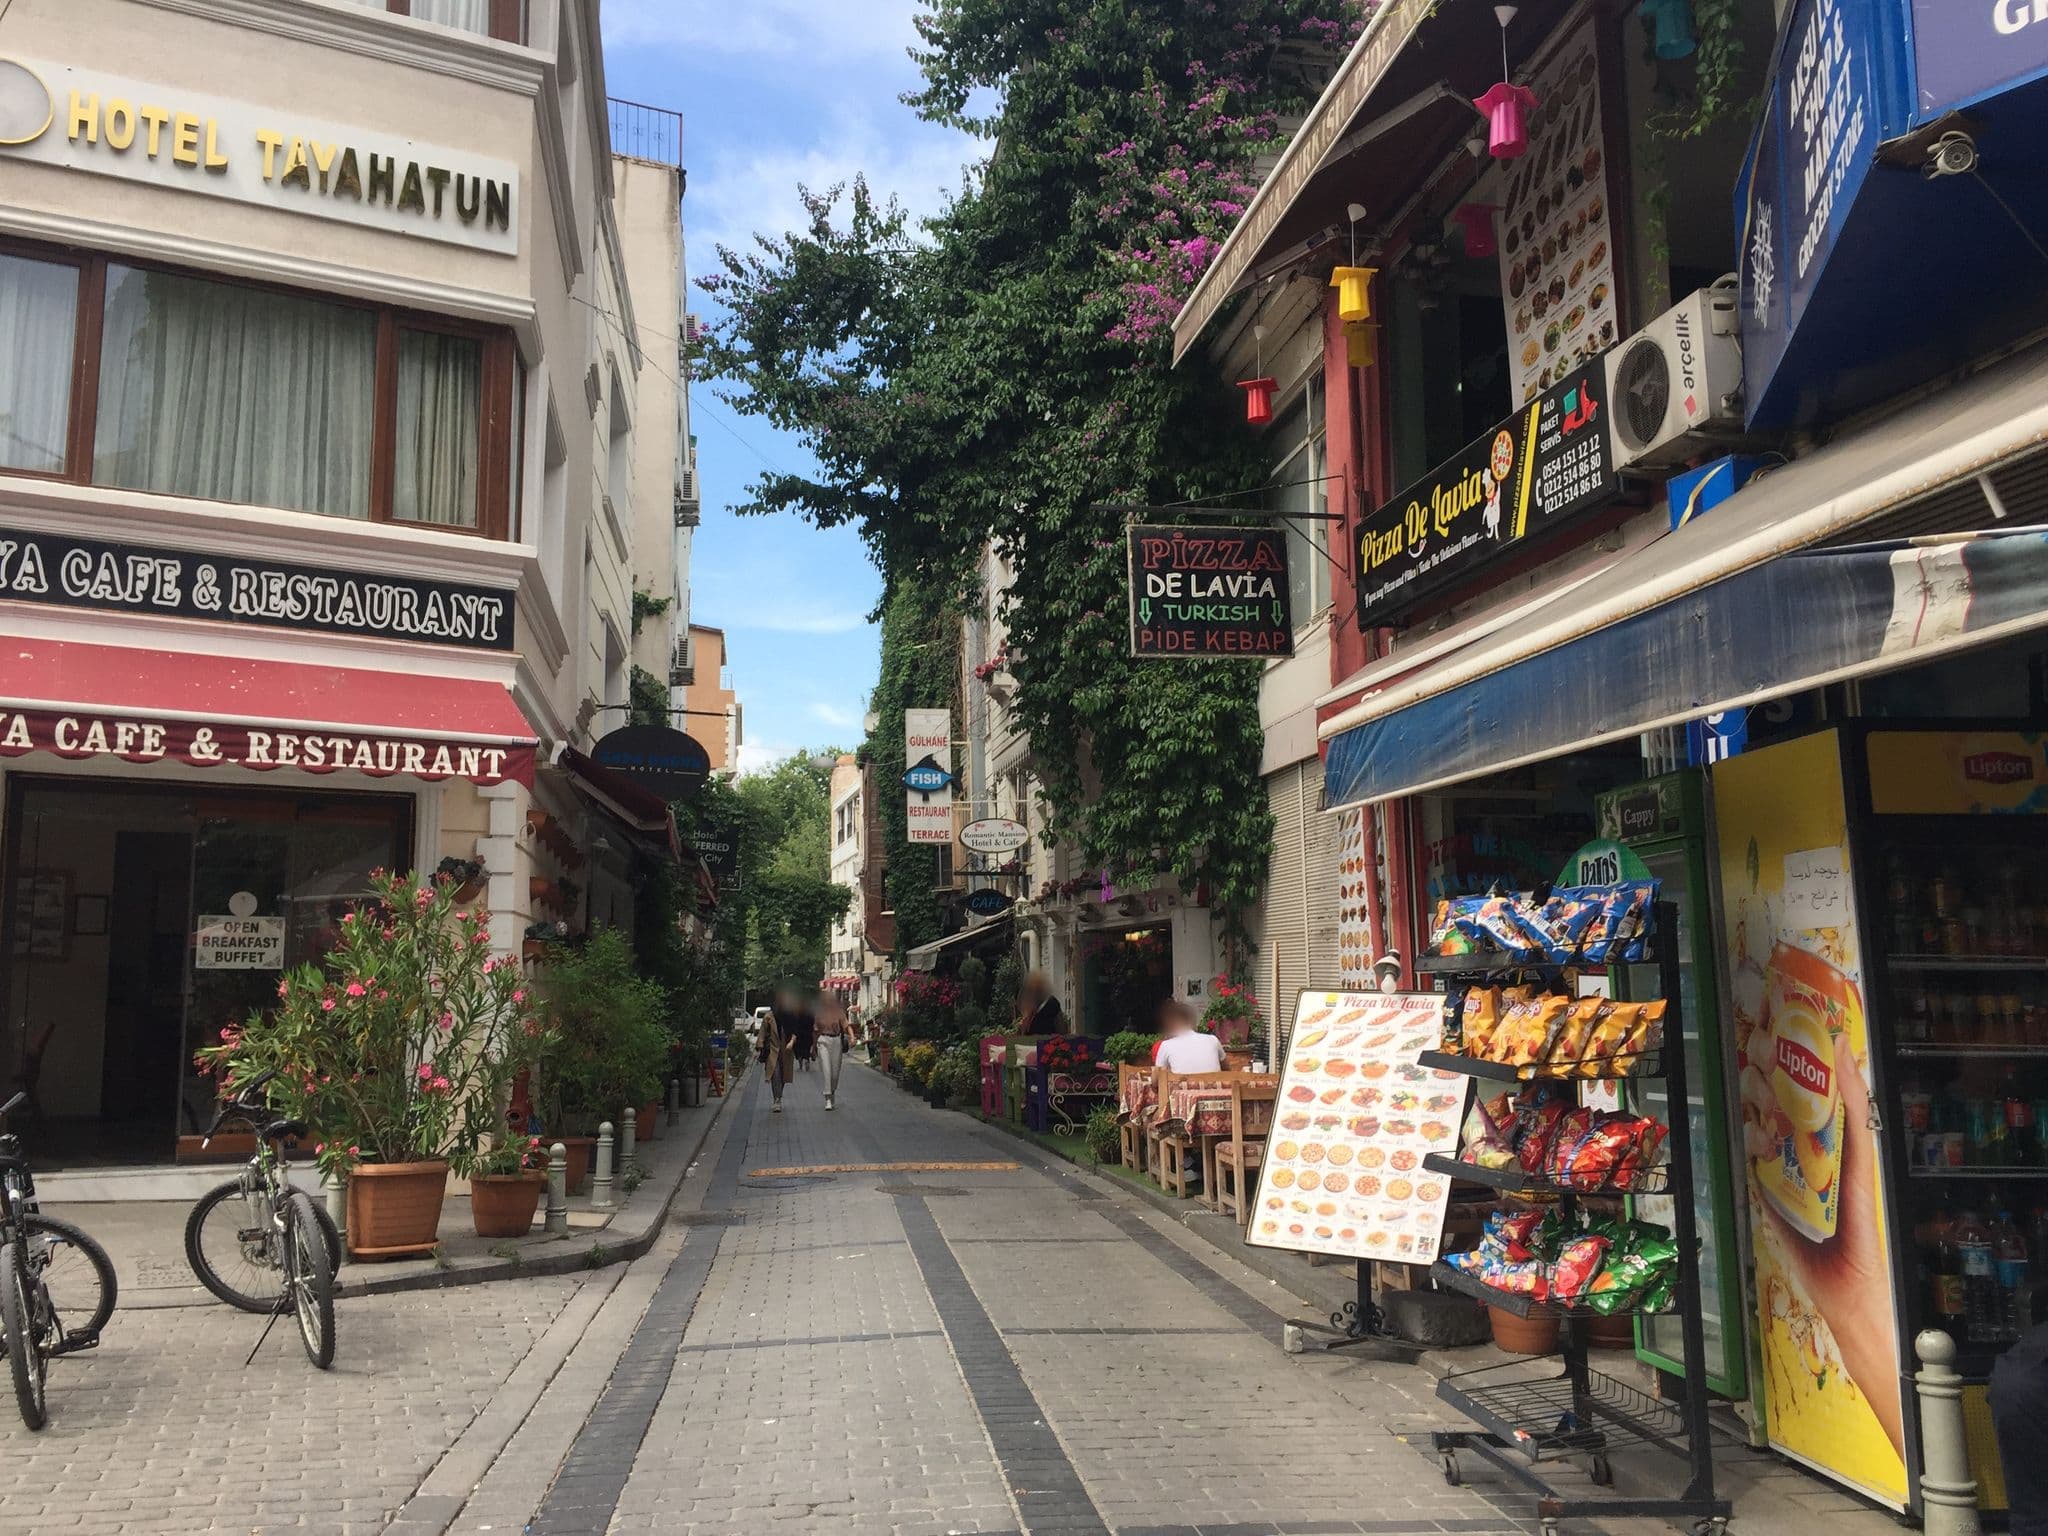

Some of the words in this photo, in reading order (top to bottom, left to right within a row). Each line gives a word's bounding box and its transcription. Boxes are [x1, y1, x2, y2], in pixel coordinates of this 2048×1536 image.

[1790, 11, 1819, 130] AKSU
[1803, 37, 1832, 152] SHOP
[1833, 7, 1845, 65] &
[1804, 47, 1852, 216] MARKET
[67, 89, 228, 173] HOTEL
[256, 128, 511, 233] TAYAHATUN
[1798, 171, 1834, 279] GROCERY
[1835, 94, 1864, 195] STORE
[1676, 314, 1694, 388] arçelik
[1542, 397, 1556, 416] ALO
[1540, 413, 1560, 436] PAKET
[1542, 456, 1561, 481] 0554
[1561, 448, 1577, 469] 151
[1578, 440, 1589, 459] 12
[1589, 433, 1601, 453] 12
[1510, 412, 1531, 537] www.pizzadelavia.com
[1543, 474, 1563, 498] 0212
[1563, 465, 1578, 487] 514
[1578, 458, 1590, 477] 86
[1590, 451, 1602, 471] 80
[1544, 492, 1564, 514] 0212
[1564, 483, 1580, 505] 514
[1579, 476, 1591, 496] 86
[1591, 470, 1603, 490] 81
[1361, 523, 1403, 574] Pizza
[1405, 500, 1429, 545] De
[1431, 467, 1483, 537] Lavia
[1141, 532, 1283, 571] PİZZA
[60, 548, 182, 608] CAFE
[192, 564, 223, 611] &
[229, 568, 503, 641] RESTAURANT
[1146, 572, 1183, 599] DE
[1190, 571, 1277, 599] LAVİA
[1162, 604, 1260, 622] TURKISH
[1140, 626, 1196, 650] PİDE
[1206, 630, 1286, 651] KEBAP
[54, 717, 167, 758] CAFE
[189, 727, 224, 761] &
[246, 731, 507, 778] RESTAURANT
[629, 765, 671, 774] HOTEL
[910, 773, 943, 785] FISH
[1970, 758, 2028, 778] Lipton
[909, 806, 950, 818] RESTAURANT
[1624, 808, 1658, 829] Cappy
[911, 829, 950, 840] TERRACE
[964, 831, 996, 839] Romantic
[998, 830, 1027, 838] Mansion
[971, 838, 992, 847] Hotel
[994, 838, 1001, 847] &
[704, 853, 723, 864] City
[223, 921, 260, 934] OPEN
[201, 935, 280, 950] BREAKFAST
[214, 951, 266, 964] BUFFET
[1344, 995, 1377, 1009] Pizza
[1381, 996, 1399, 1009] De
[1400, 997, 1436, 1013] Lavia
[1779, 1043, 1827, 1090] Lipton
